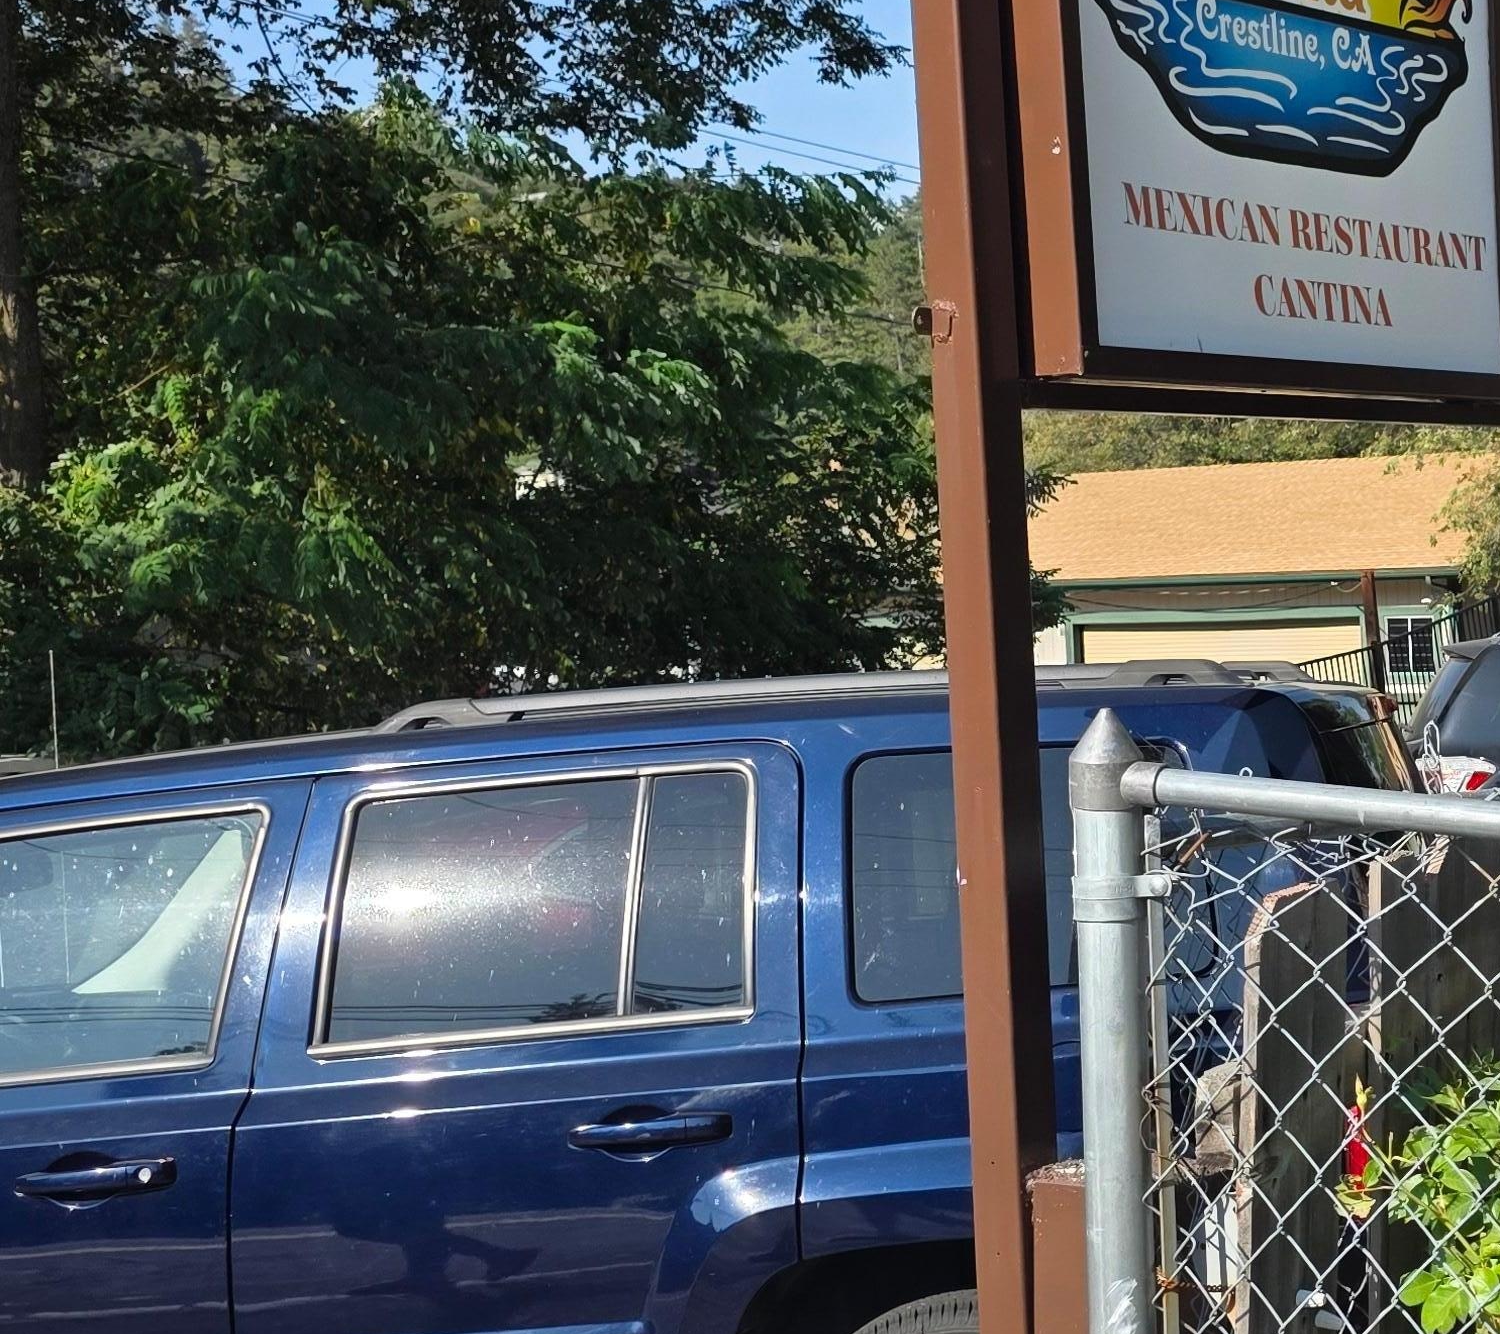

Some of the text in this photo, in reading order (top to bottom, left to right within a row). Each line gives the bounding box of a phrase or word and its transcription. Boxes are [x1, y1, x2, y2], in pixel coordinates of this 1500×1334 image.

[1332, 27, 1376, 76] CA
[1121, 181, 1487, 272] MEXICAN RESTAURANT
[1253, 273, 1394, 328] CANTINA
